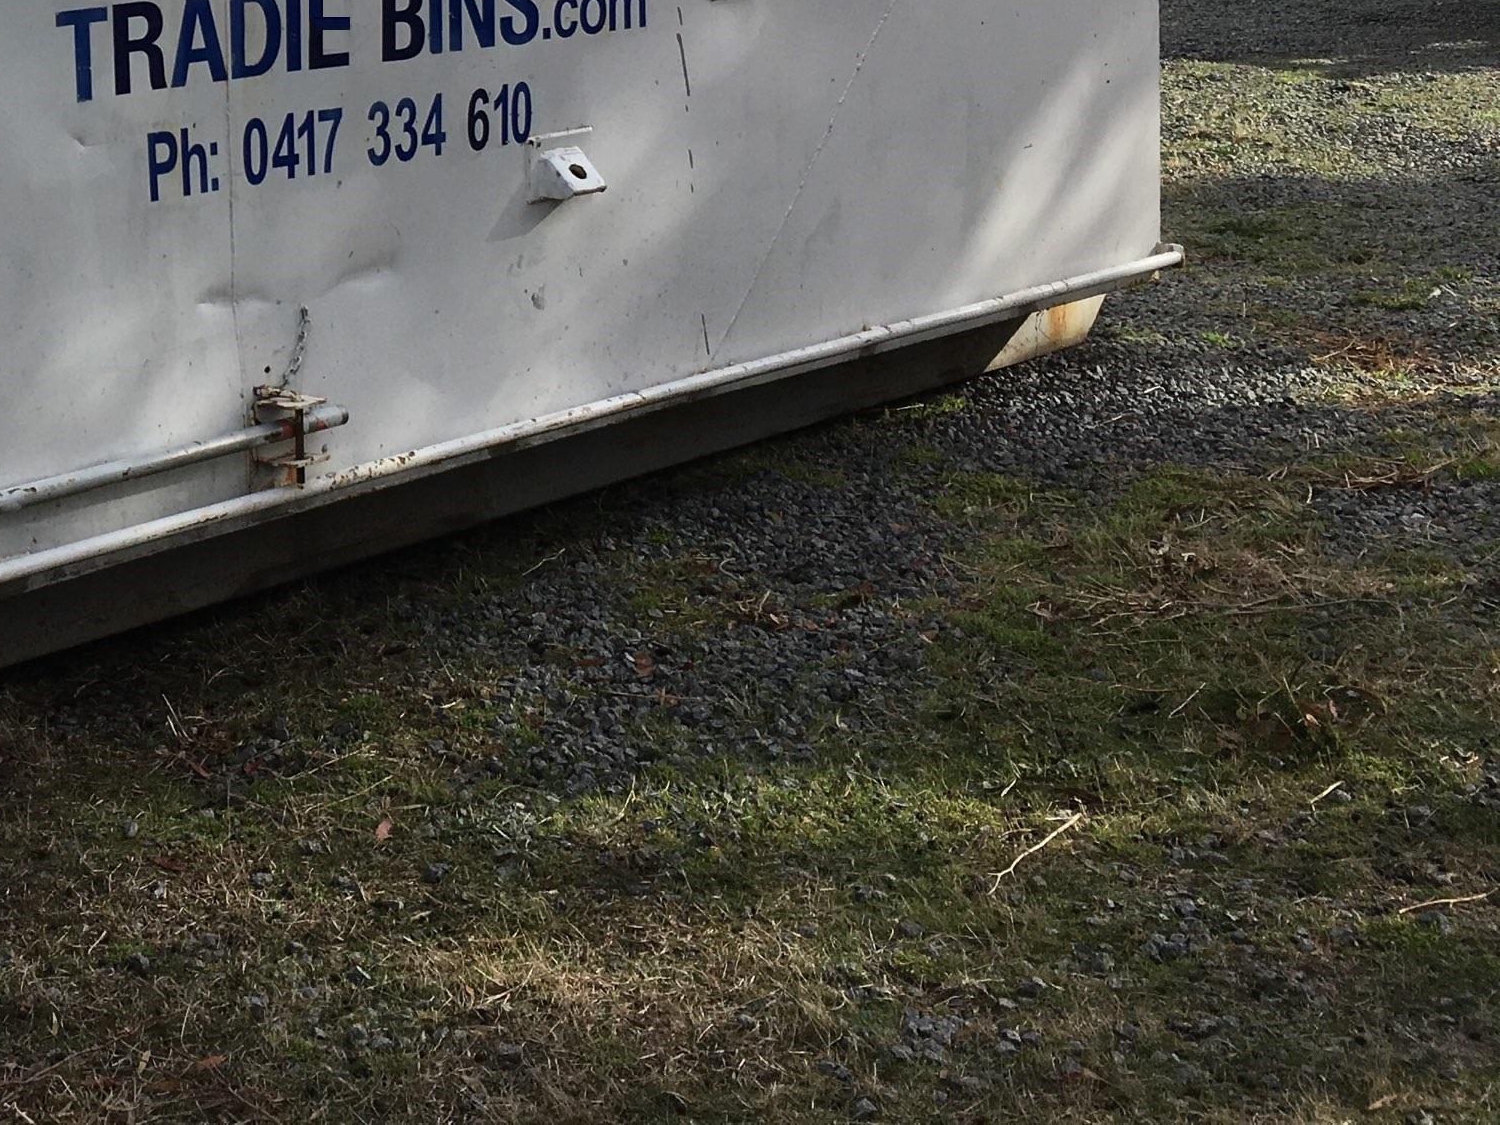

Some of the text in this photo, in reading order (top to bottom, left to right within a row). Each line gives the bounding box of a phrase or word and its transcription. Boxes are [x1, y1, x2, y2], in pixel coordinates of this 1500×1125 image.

[148, 81, 532, 202] Ph: 0417 334 610
